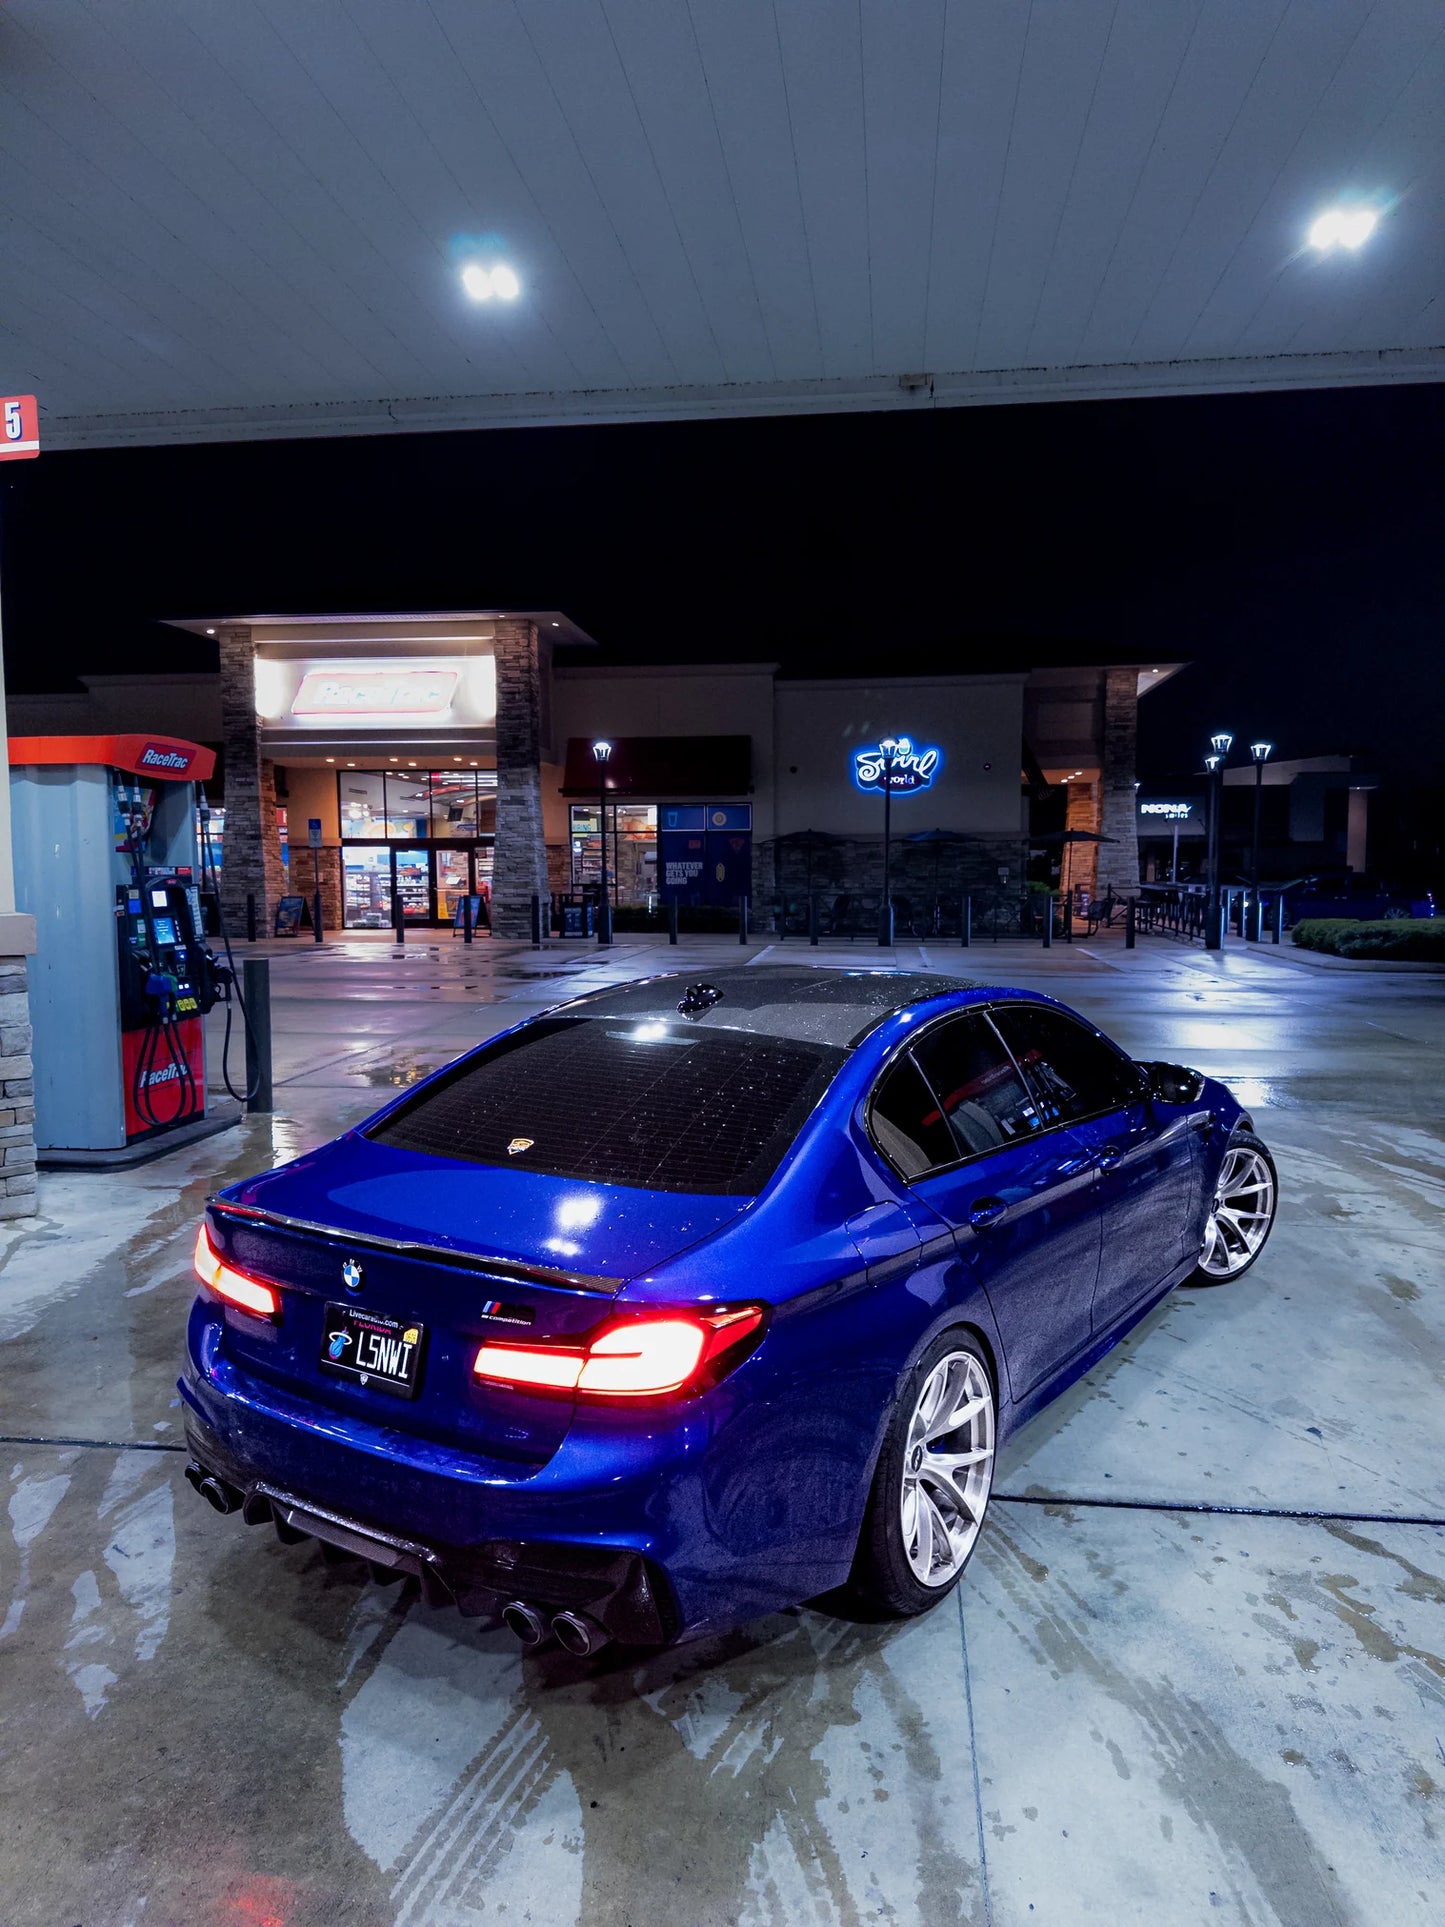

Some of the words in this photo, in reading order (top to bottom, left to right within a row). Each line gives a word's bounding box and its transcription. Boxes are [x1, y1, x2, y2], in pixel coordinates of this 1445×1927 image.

[5, 401, 22, 441] 5
[142, 748, 188, 769] RaceTrac
[665, 861, 704, 870] WHATEVER
[665, 869, 684, 878] GETS
[685, 869, 699, 878] YOU
[665, 877, 688, 885] GOING
